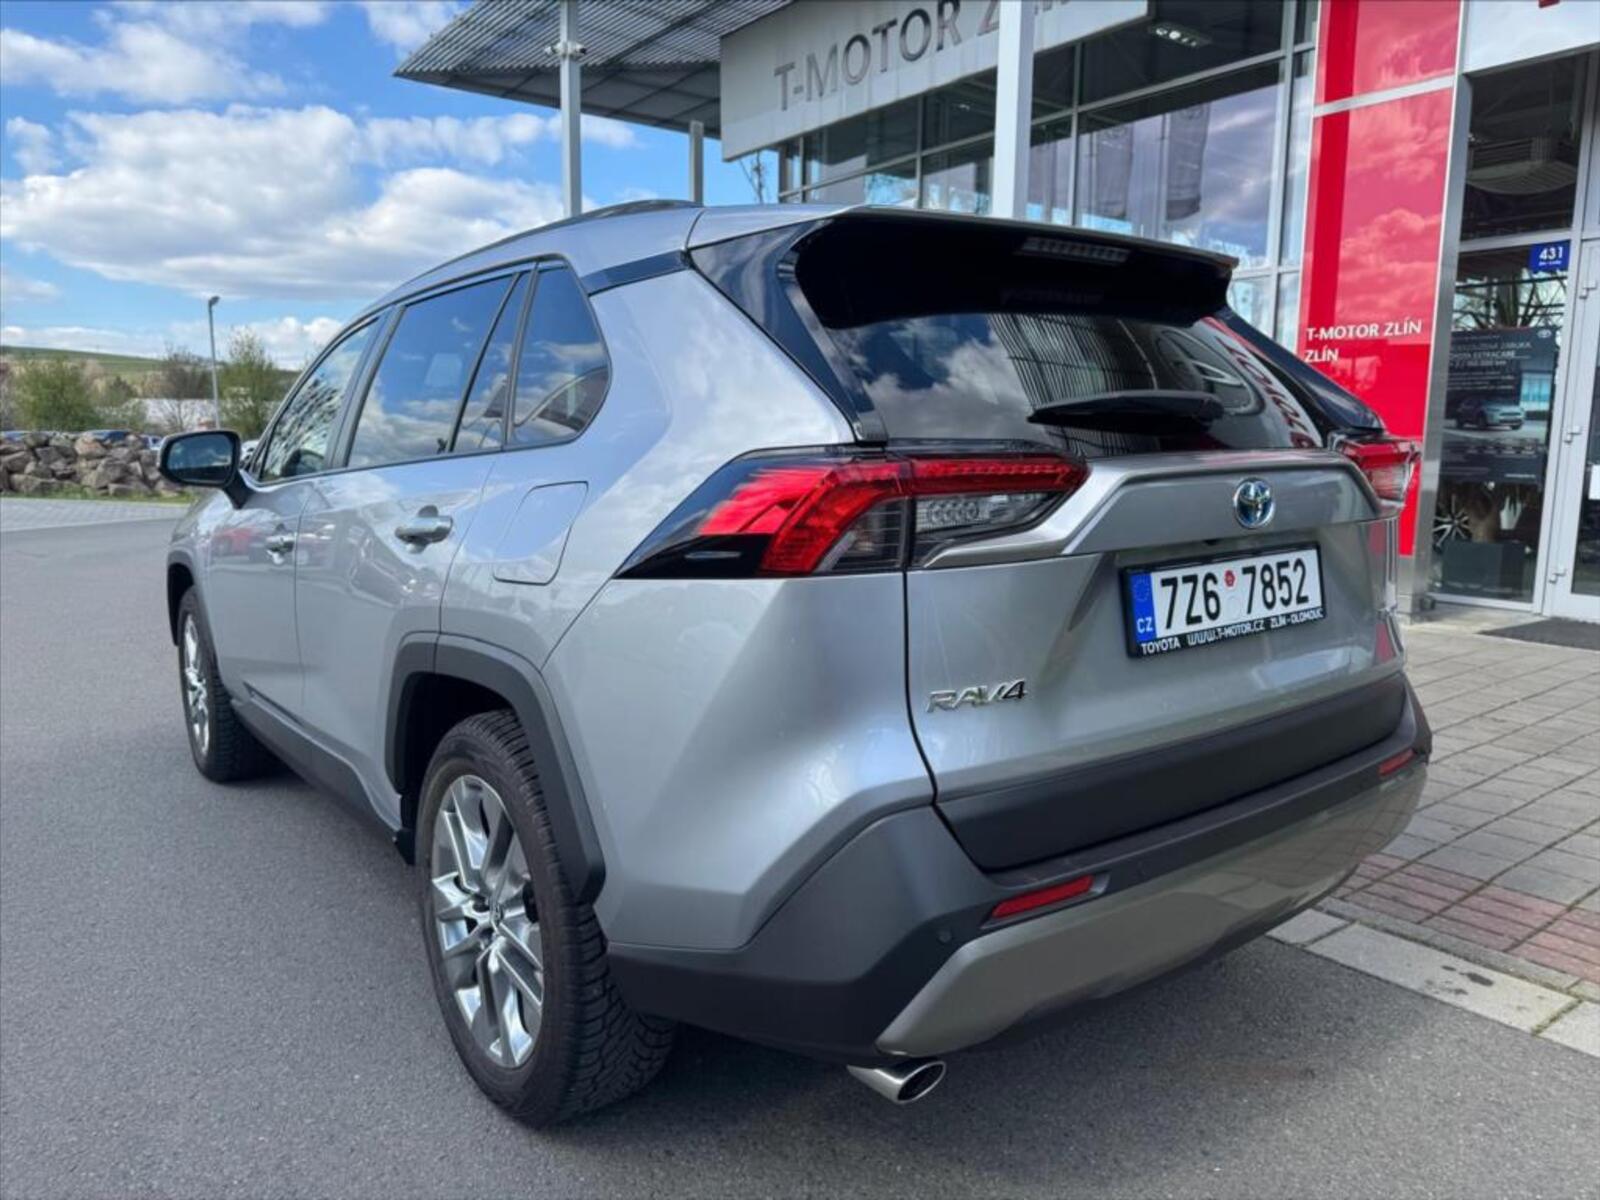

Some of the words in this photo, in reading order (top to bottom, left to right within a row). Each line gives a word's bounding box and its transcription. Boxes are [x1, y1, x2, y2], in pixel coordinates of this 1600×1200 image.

[774, 0, 962, 111] T-MOTOR
[1539, 246, 1563, 260] 431
[1306, 323, 1379, 341] T-MOTOR
[1384, 317, 1422, 337] ZLÍN
[1304, 345, 1339, 363] ZLÍN
[1160, 571, 1221, 630] 7Z6
[1242, 558, 1309, 615] 7852
[1136, 616, 1153, 634] CZ
[1141, 636, 1181, 655] TOYOTA
[926, 678, 1028, 713] RAV4
